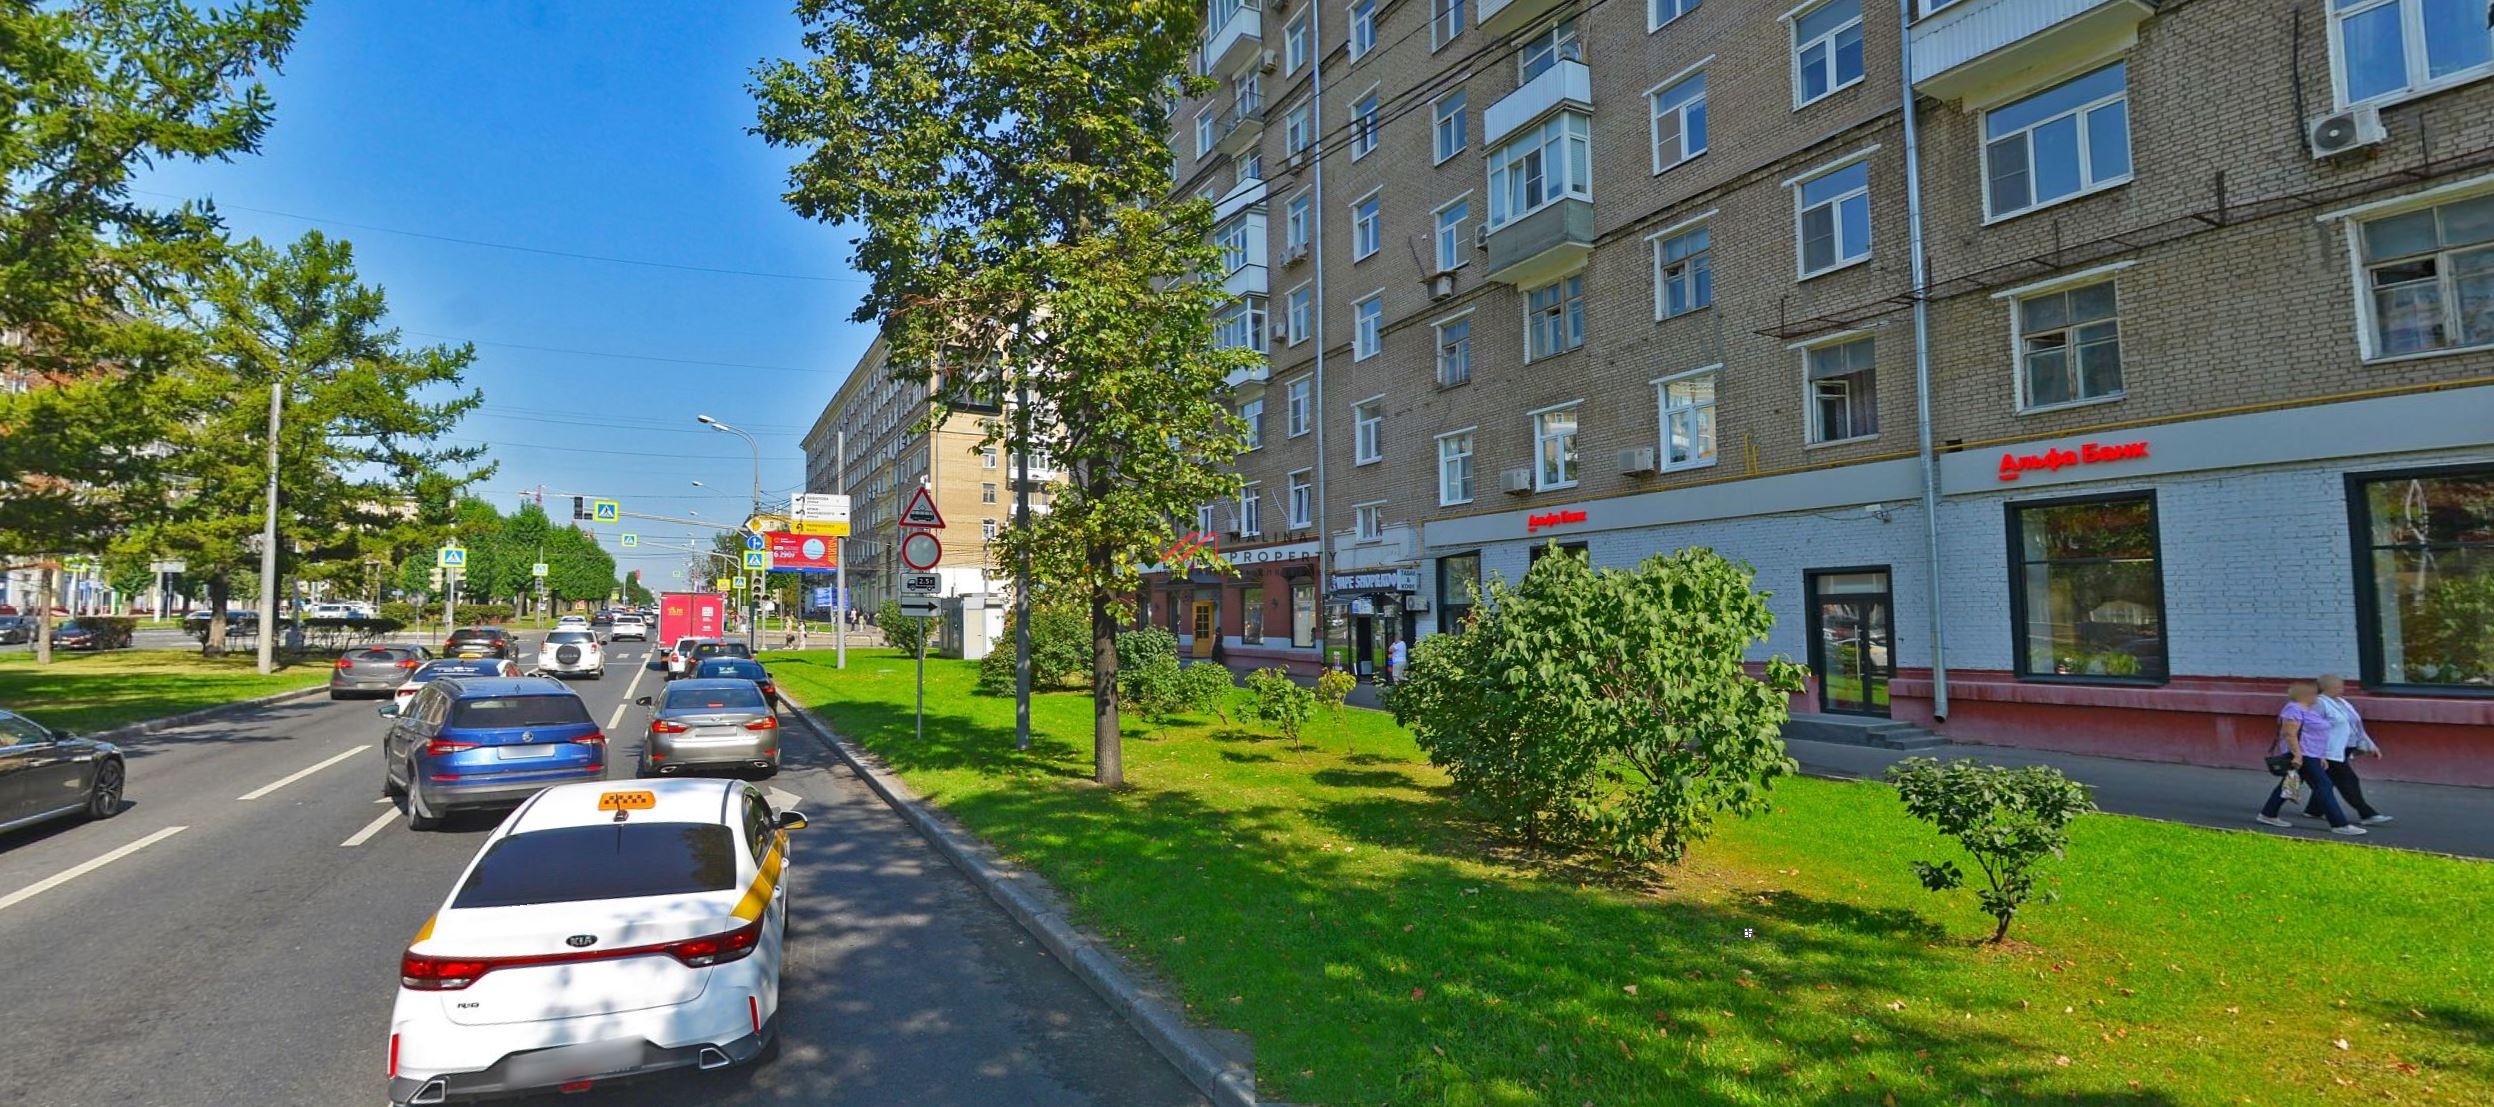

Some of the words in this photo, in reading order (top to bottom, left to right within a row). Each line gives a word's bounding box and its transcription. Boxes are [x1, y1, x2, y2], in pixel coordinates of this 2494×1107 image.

[1998, 448, 2078, 476] Альфа
[2080, 442, 2149, 464] Банк
[1528, 512, 1560, 529] Альфа
[1560, 510, 1587, 523] Банк
[568, 935, 594, 947] KIA
